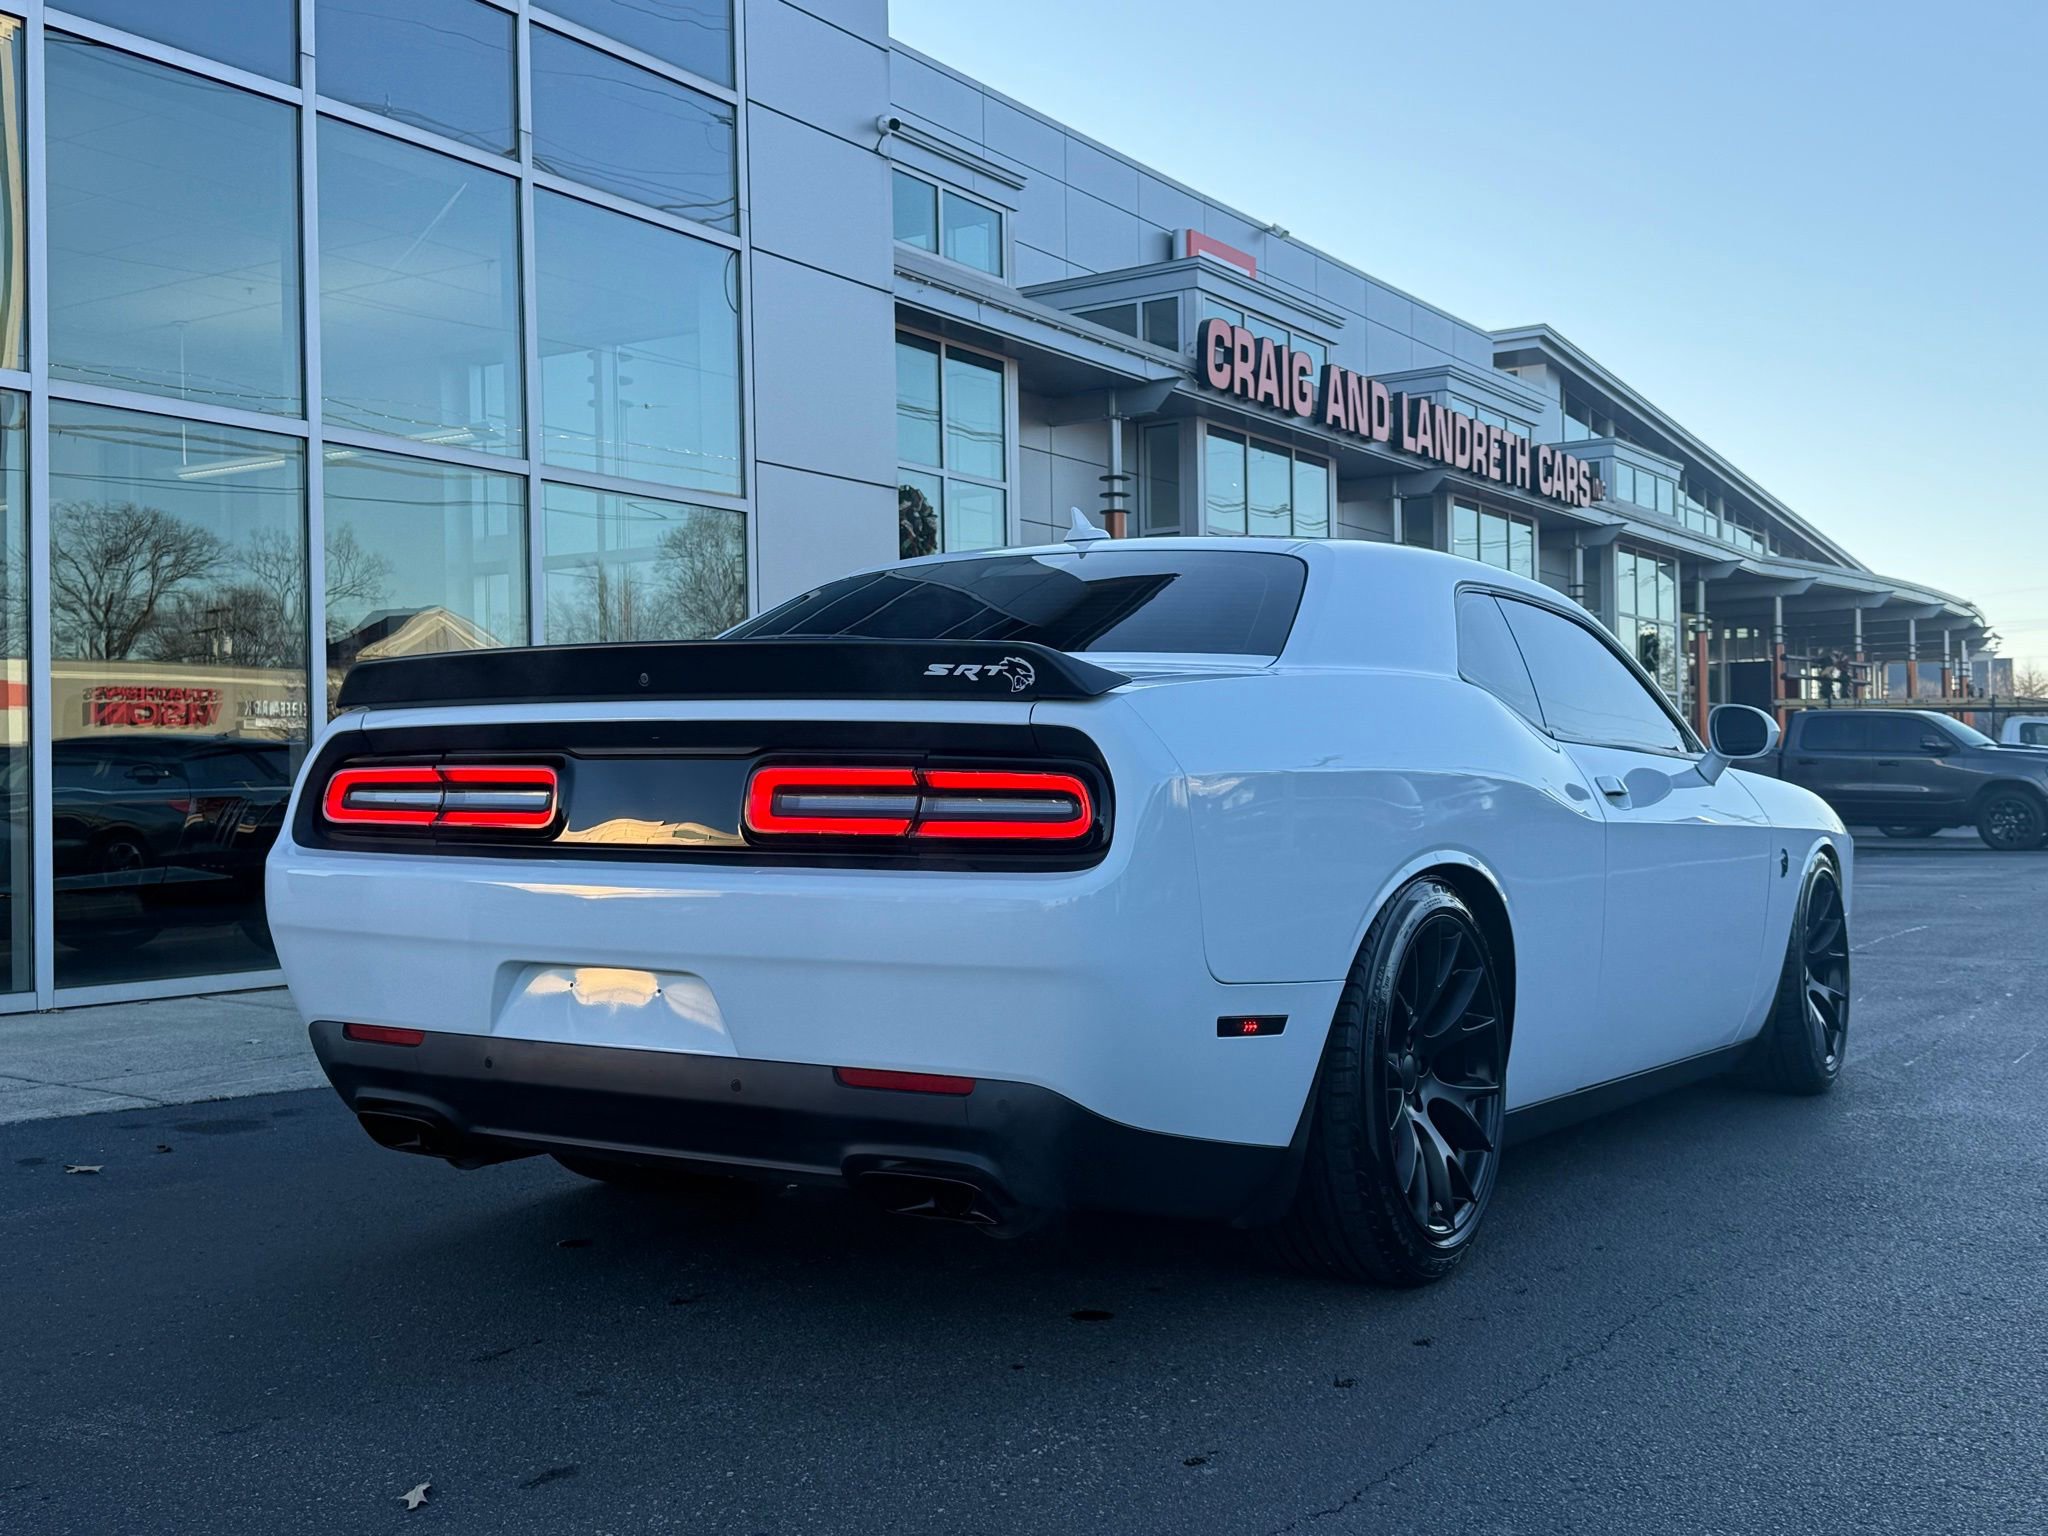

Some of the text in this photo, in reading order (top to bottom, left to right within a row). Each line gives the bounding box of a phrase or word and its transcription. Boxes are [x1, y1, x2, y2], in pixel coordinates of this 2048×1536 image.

[1204, 318, 1314, 417] CRAIG
[1323, 364, 1390, 443] AND
[1401, 391, 1531, 490] LANDRETH
[1537, 444, 1591, 508] CARS
[923, 663, 1009, 681] SRT
